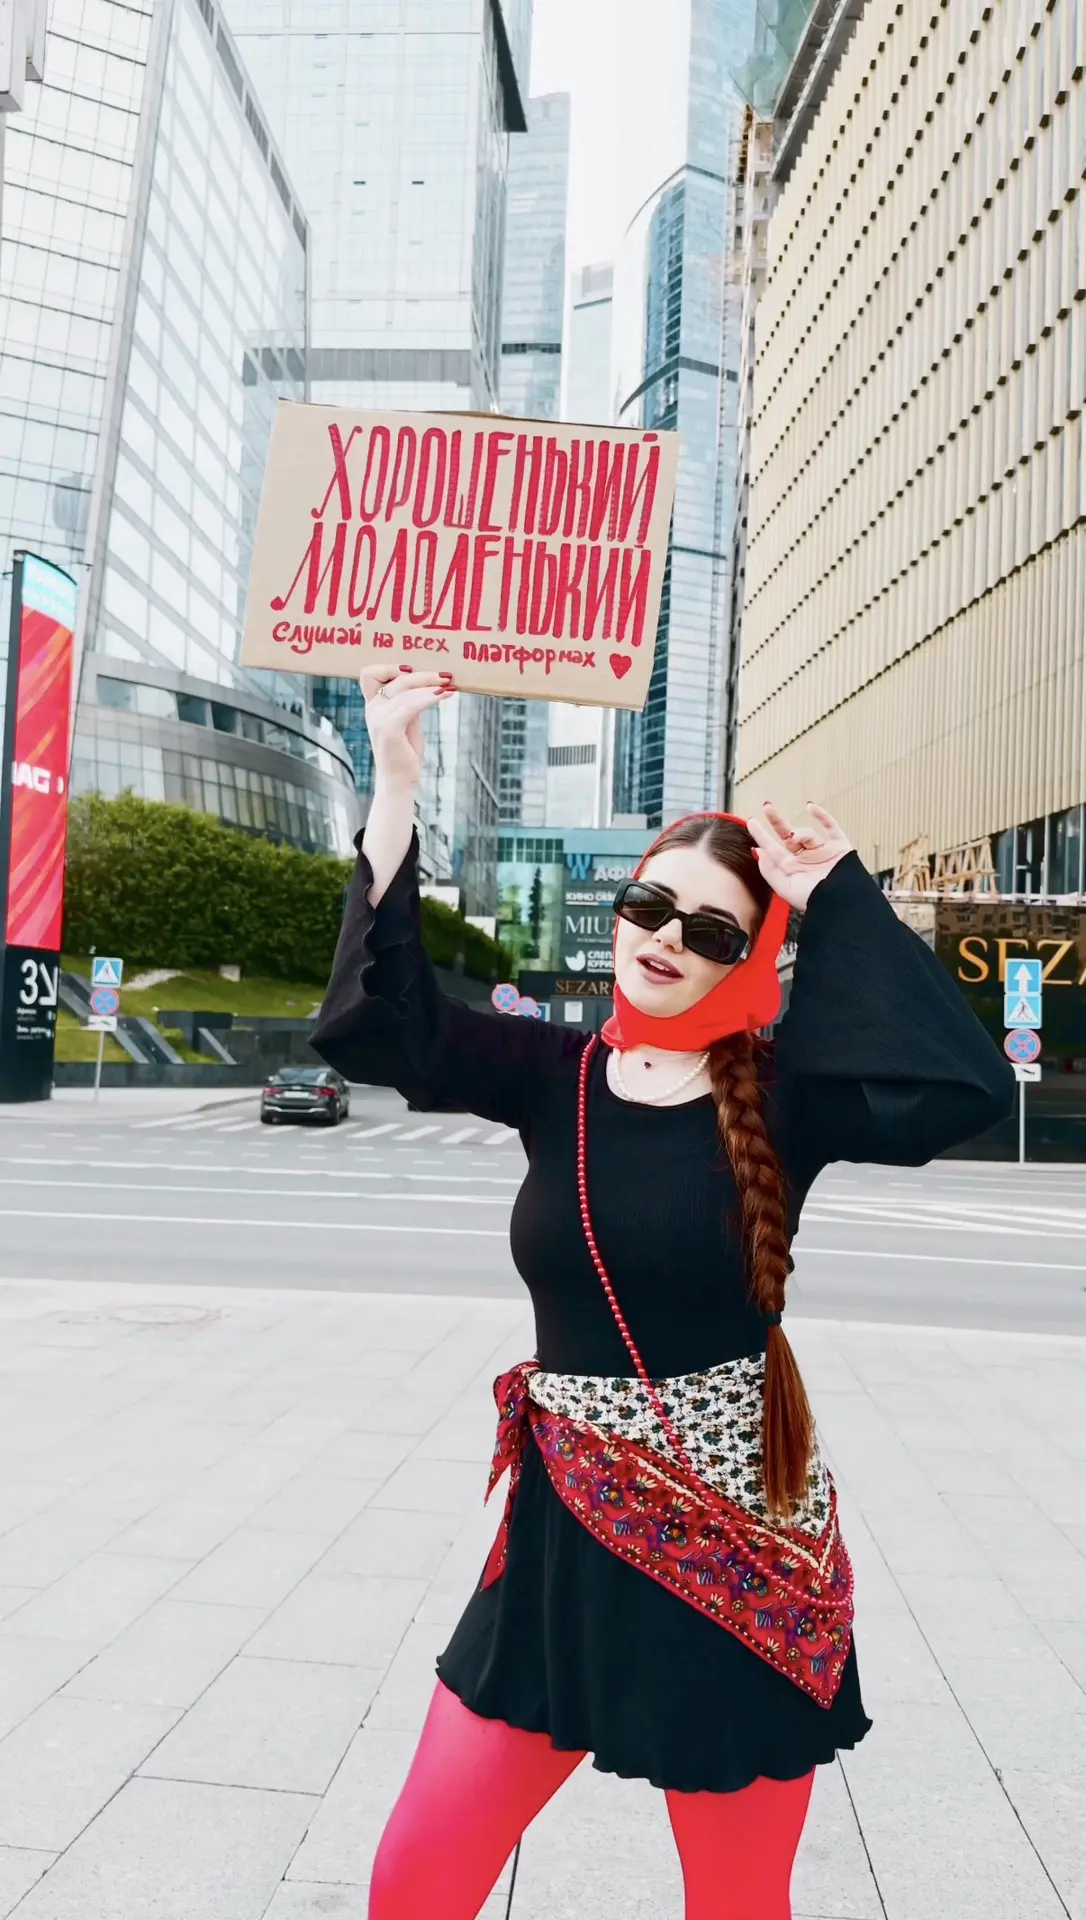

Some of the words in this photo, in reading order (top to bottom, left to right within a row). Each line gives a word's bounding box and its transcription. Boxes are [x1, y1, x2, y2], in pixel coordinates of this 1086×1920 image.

[310, 422, 661, 544] ХОРОШЕНЬКИЙ
[270, 520, 651, 648] МОЛОДЕНЬКИЙ
[372, 631, 394, 649] на
[402, 634, 449, 653] всех
[463, 640, 596, 675] платформах
[565, 915, 616, 935] MIU
